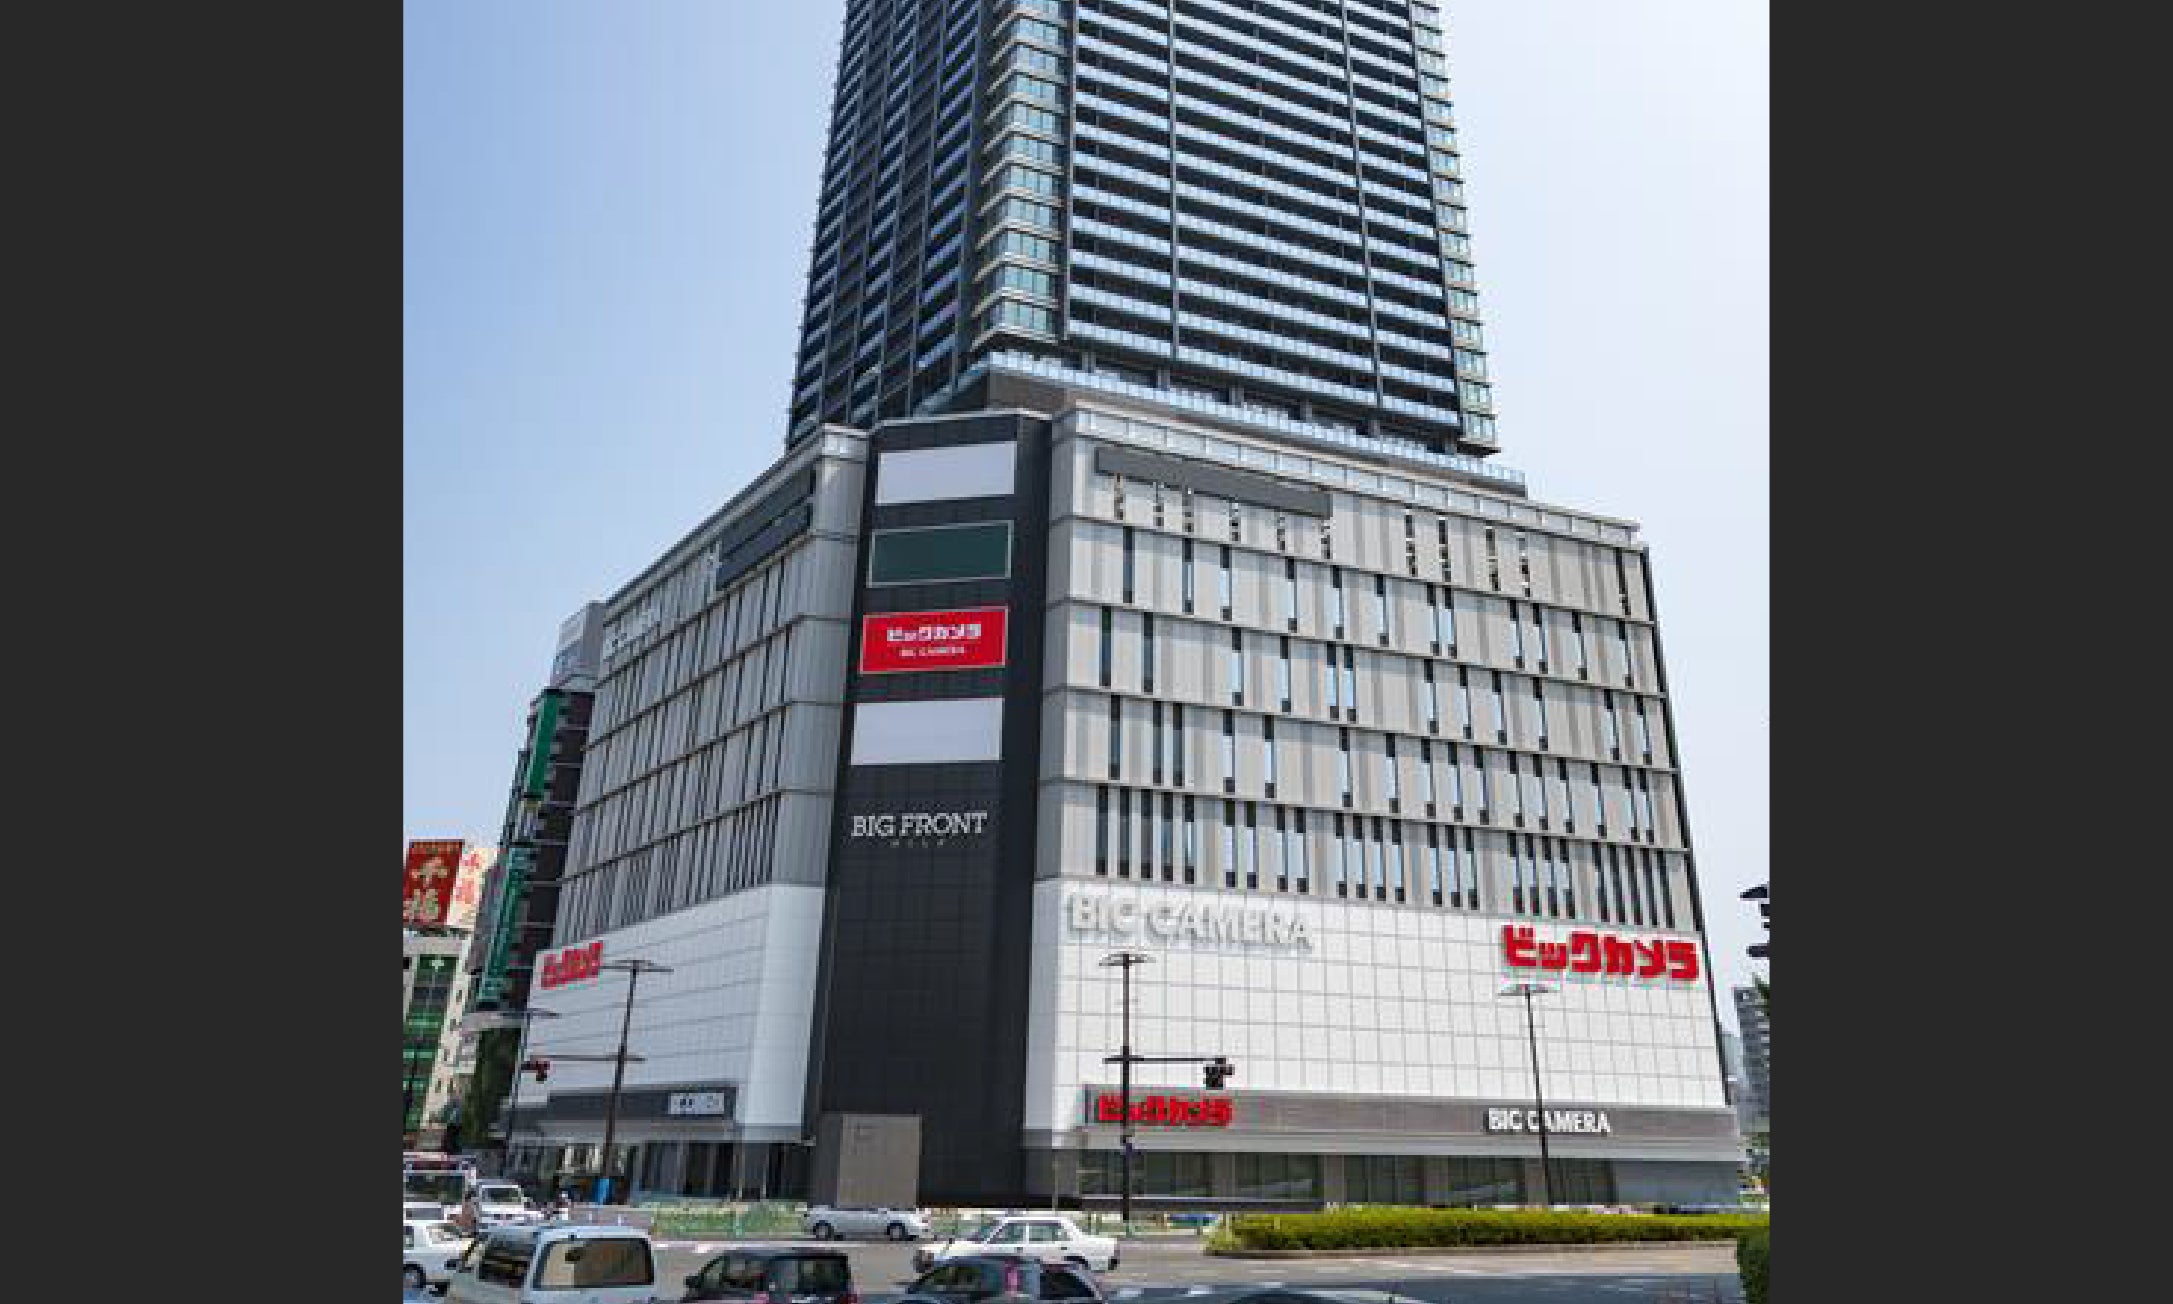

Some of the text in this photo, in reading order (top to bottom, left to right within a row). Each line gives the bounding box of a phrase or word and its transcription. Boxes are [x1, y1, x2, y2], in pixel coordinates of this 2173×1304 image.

[886, 624, 982, 642] ビックカメラ
[851, 811, 988, 837] BIG FRONT
[1069, 893, 1311, 949] BIC CAMERA
[1501, 923, 1700, 981] ビックカメラ
[1488, 1107, 1523, 1130] BIC
